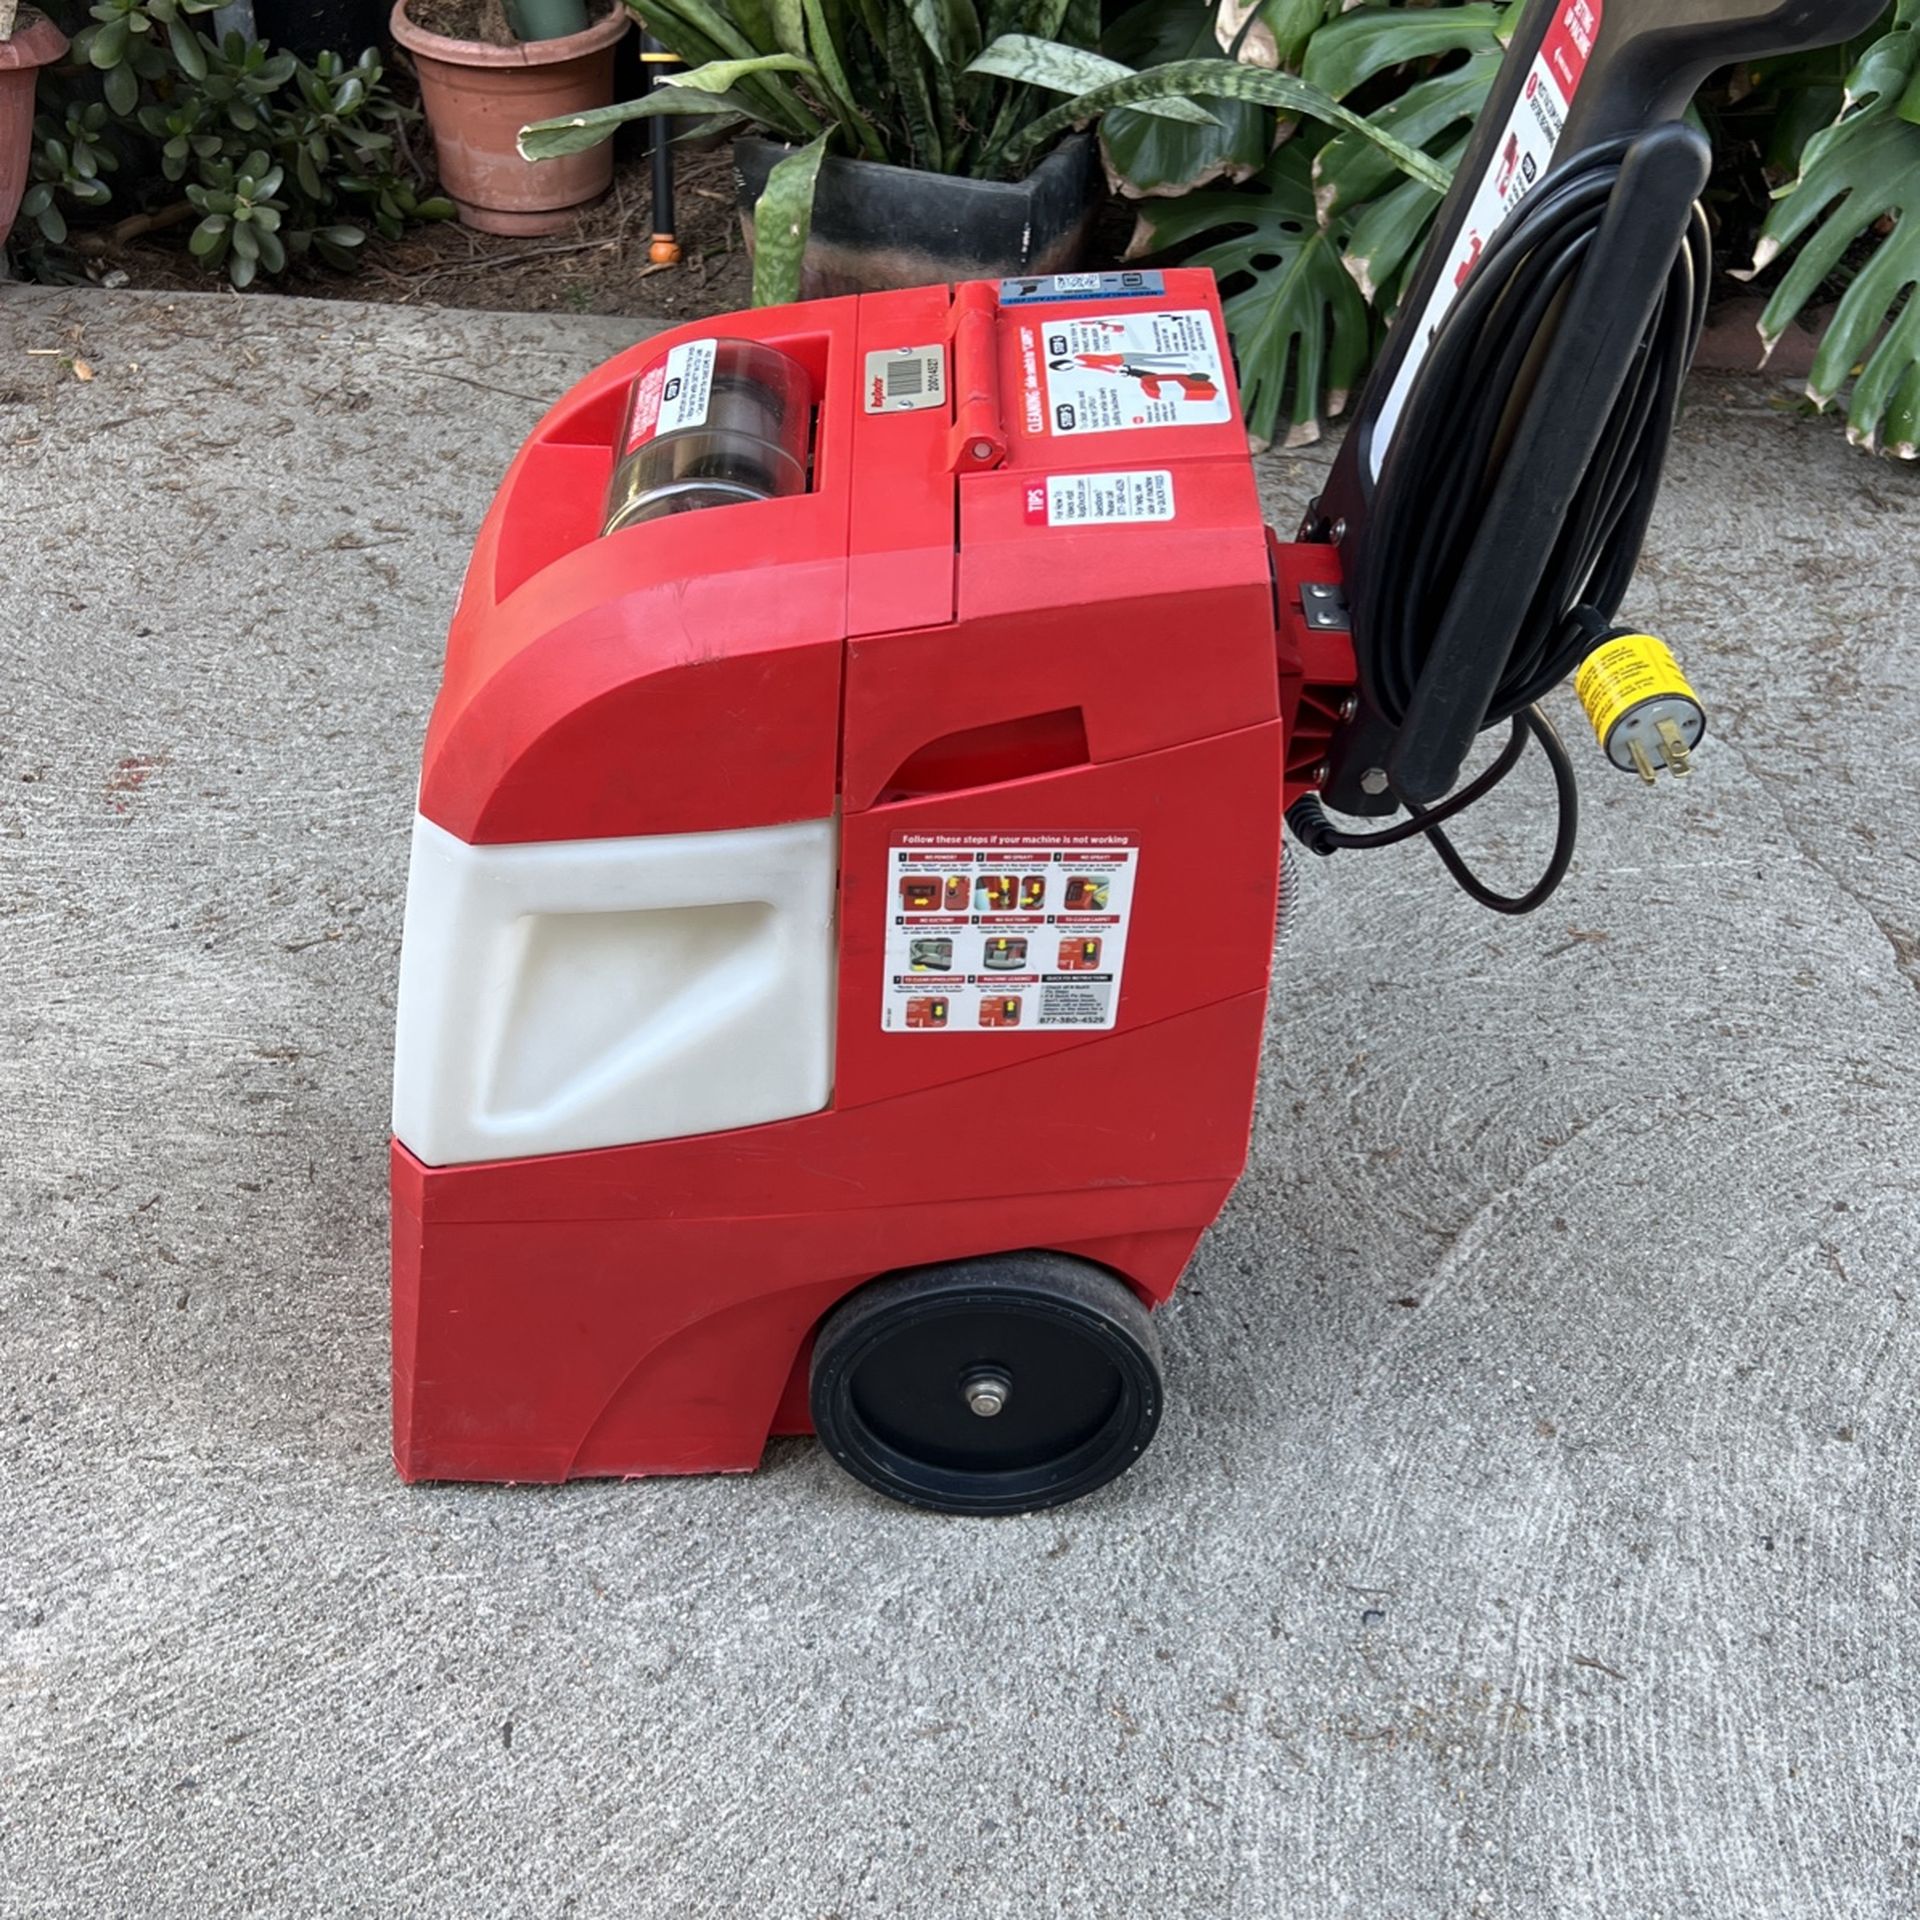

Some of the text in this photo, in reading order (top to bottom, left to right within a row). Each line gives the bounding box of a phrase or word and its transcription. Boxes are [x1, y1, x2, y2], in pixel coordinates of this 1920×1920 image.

[927, 358, 940, 392] 20014527
[1025, 390, 1044, 432] CLEANING
[1028, 488, 1044, 512] TIPS
[902, 835, 934, 843] Follow
[936, 835, 962, 843] these
[964, 836, 988, 844] steps
[990, 835, 998, 843] if
[999, 837, 1020, 845] your
[1022, 835, 1062, 844] machine
[1063, 835, 1071, 844] is
[1090, 835, 1129, 845] working
